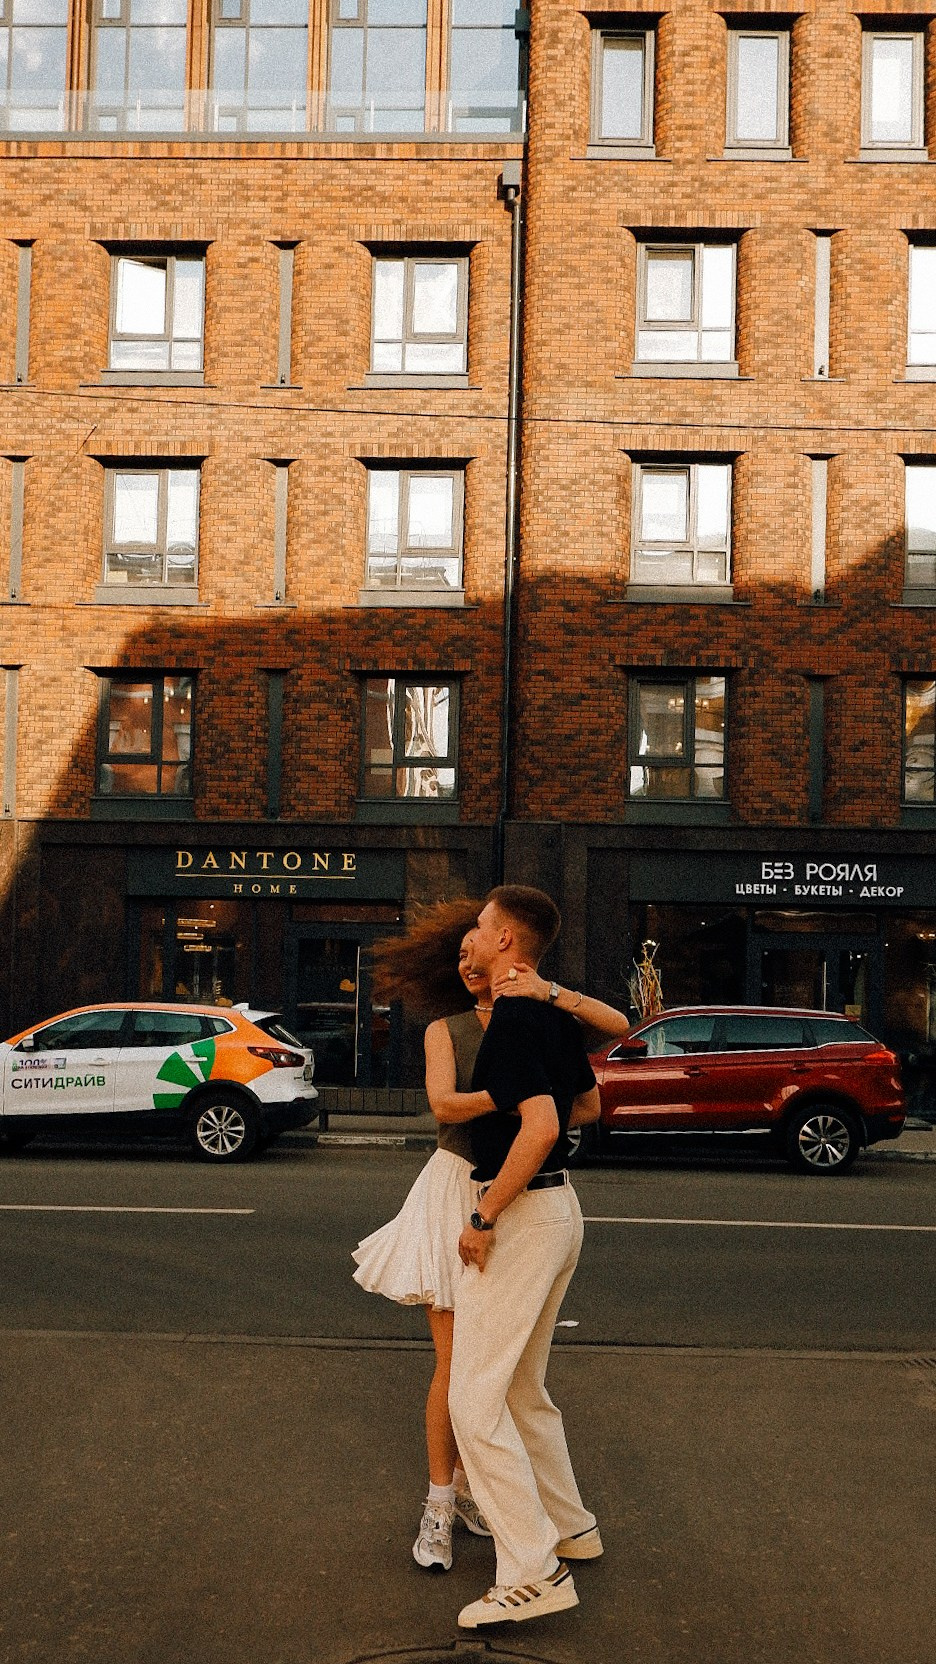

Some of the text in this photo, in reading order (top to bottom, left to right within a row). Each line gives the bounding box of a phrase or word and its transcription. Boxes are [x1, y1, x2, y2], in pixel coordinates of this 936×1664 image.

[176, 851, 356, 870] DANTONE
[762, 861, 878, 881] БЕЗ РОЯЛЯ
[234, 884, 297, 894] HOME
[735, 883, 904, 897] ЦВЕТЫ БУКЕТЫ ДЕКОР
[11, 1074, 106, 1090] СИТИДРАЙВ
